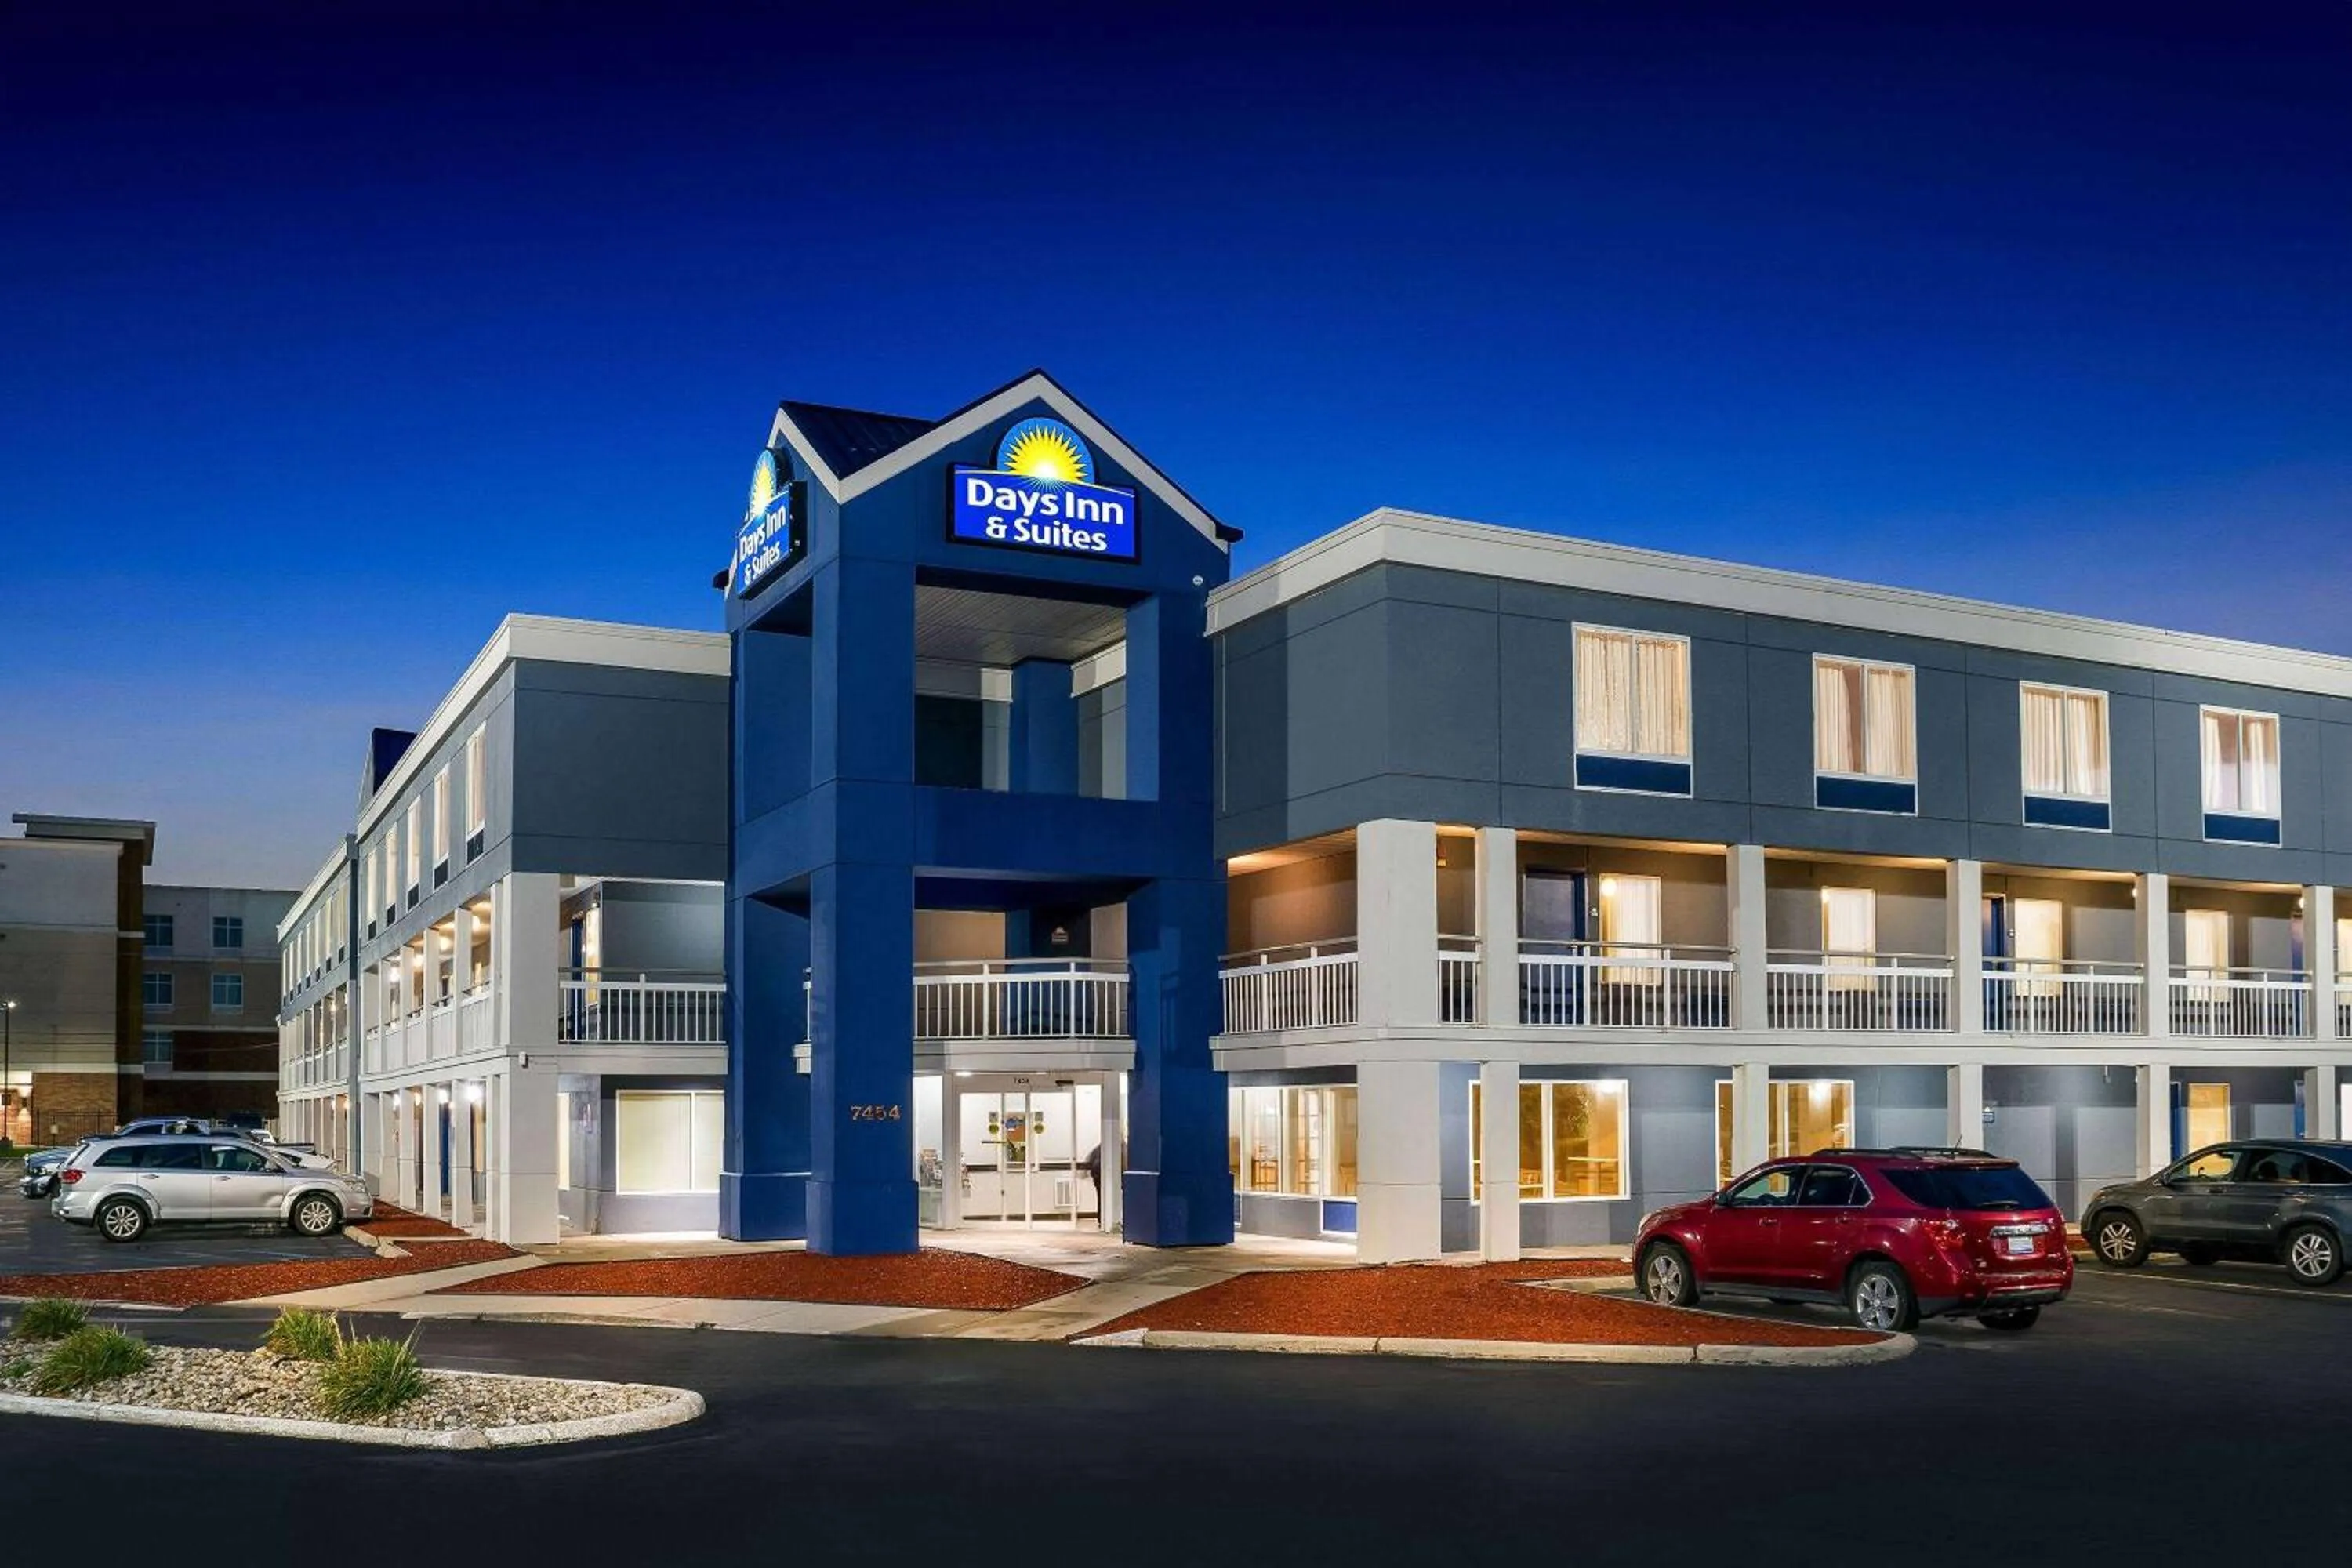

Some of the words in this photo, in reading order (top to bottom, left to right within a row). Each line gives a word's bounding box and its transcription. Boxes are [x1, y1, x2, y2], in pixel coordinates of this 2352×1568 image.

[967, 477, 1058, 517] Days
[1065, 491, 1123, 524] Inn
[739, 523, 766, 563] Days
[766, 506, 786, 539] Inn
[985, 516, 1007, 539] &
[1014, 517, 1108, 551] Suites
[744, 564, 752, 585] &
[752, 541, 780, 579] Suites
[851, 1105, 901, 1120] 7454
